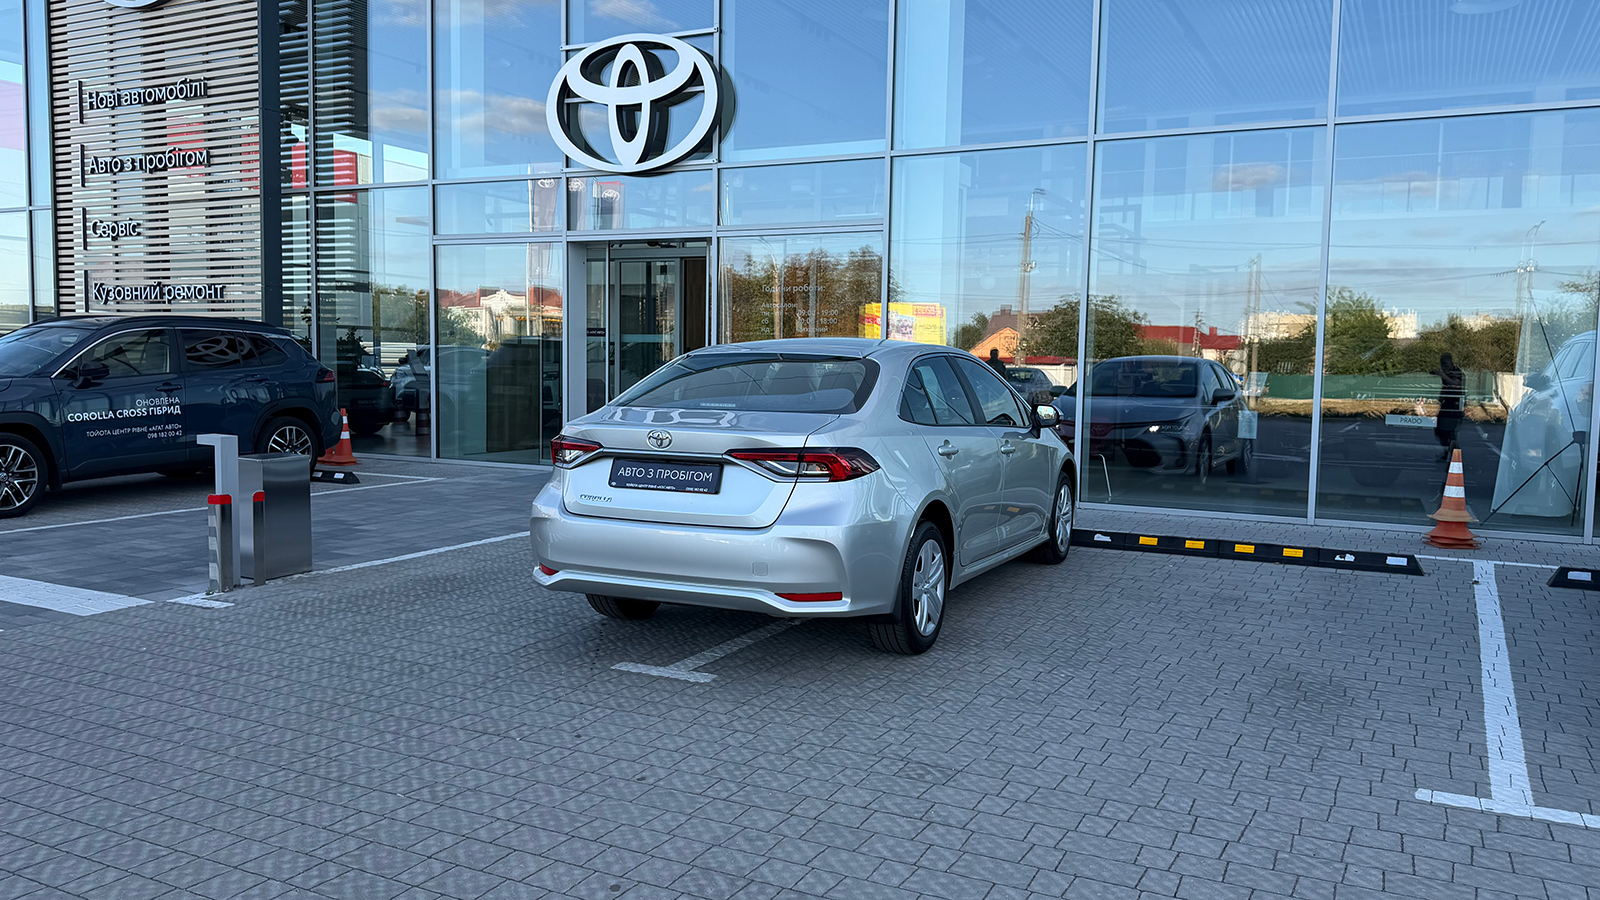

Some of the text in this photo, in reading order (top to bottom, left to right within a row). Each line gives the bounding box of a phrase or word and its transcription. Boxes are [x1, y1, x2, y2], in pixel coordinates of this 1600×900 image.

[86, 77, 207, 110] Нові автомобілі
[88, 147, 209, 174] Авто з пробігом
[91, 217, 140, 240] Сервіс
[92, 281, 225, 304] Кузовний ремонт
[136, 397, 180, 407] ОНОВЛЕНА
[67, 405, 181, 422] COROLLA CROSS ГІБРИД
[86, 429, 111, 437] ТОЙОТА
[112, 428, 131, 436] ЦЕНТР
[618, 467, 645, 478] АВТО
[656, 469, 713, 482] ПРОБІГОМ
